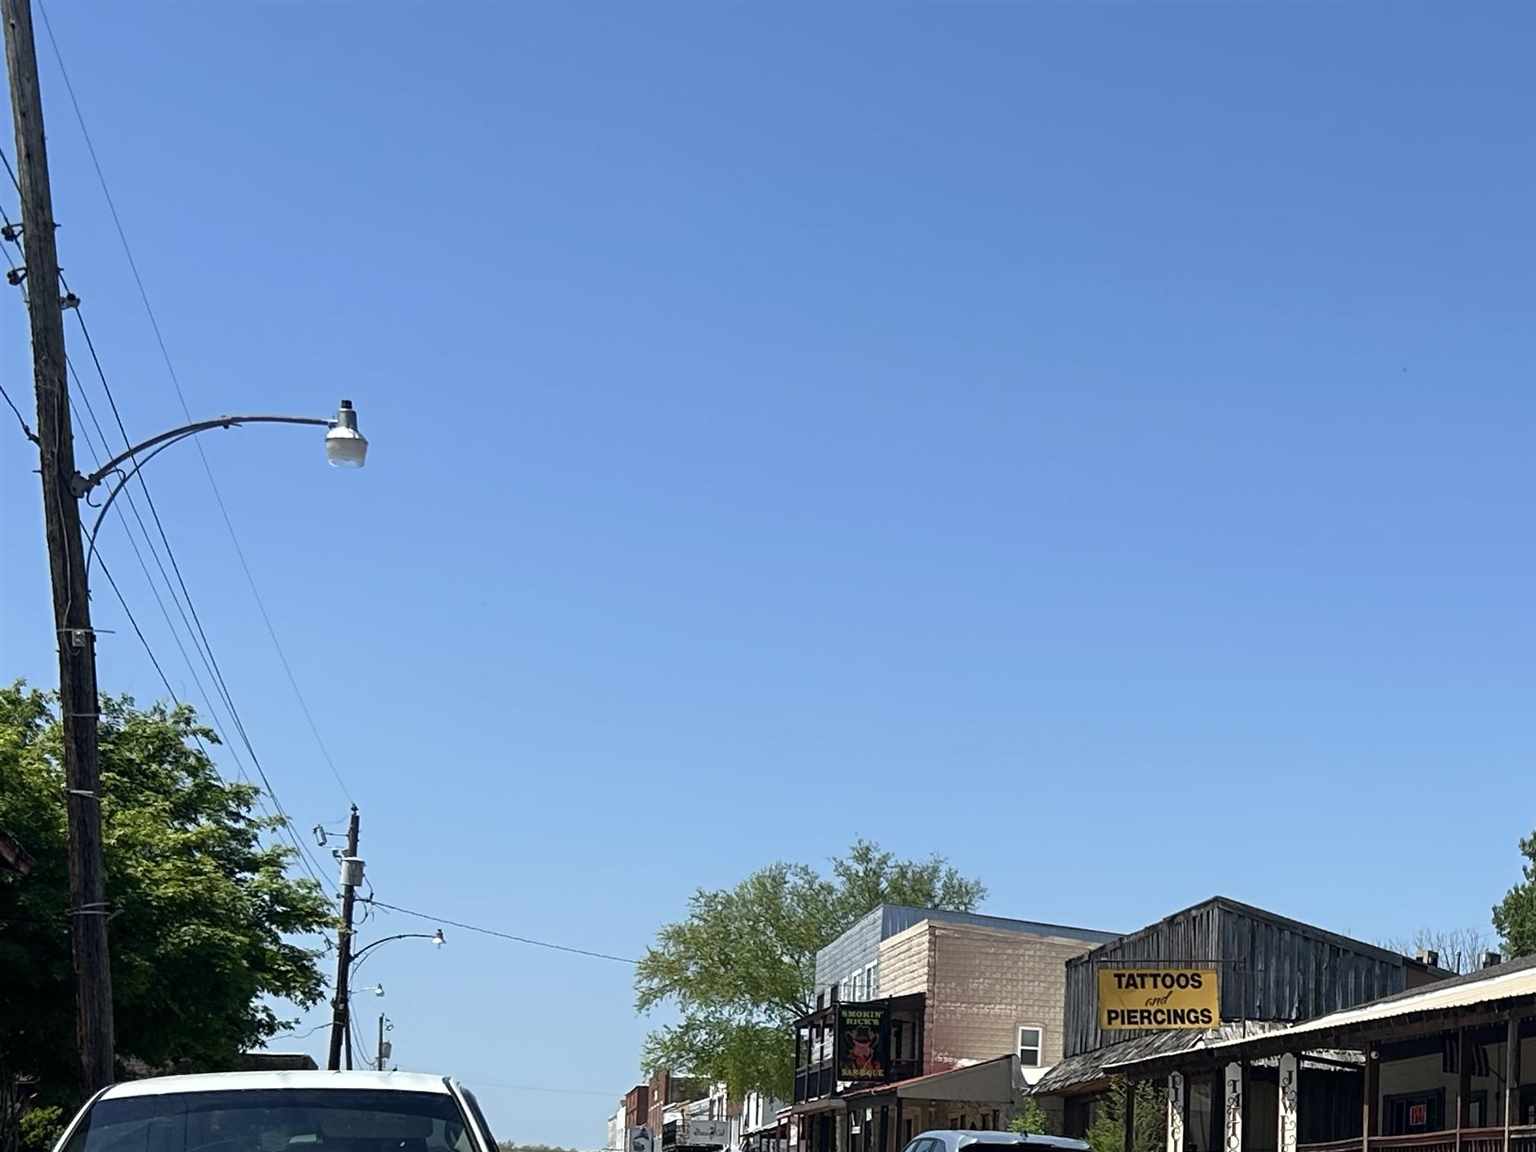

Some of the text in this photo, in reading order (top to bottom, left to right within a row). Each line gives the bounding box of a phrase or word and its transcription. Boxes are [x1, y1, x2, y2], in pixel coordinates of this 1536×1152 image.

[1113, 972, 1203, 990] TATTOOS
[1144, 990, 1173, 1007] and
[1106, 1008, 1213, 1026] PIERCINGS
